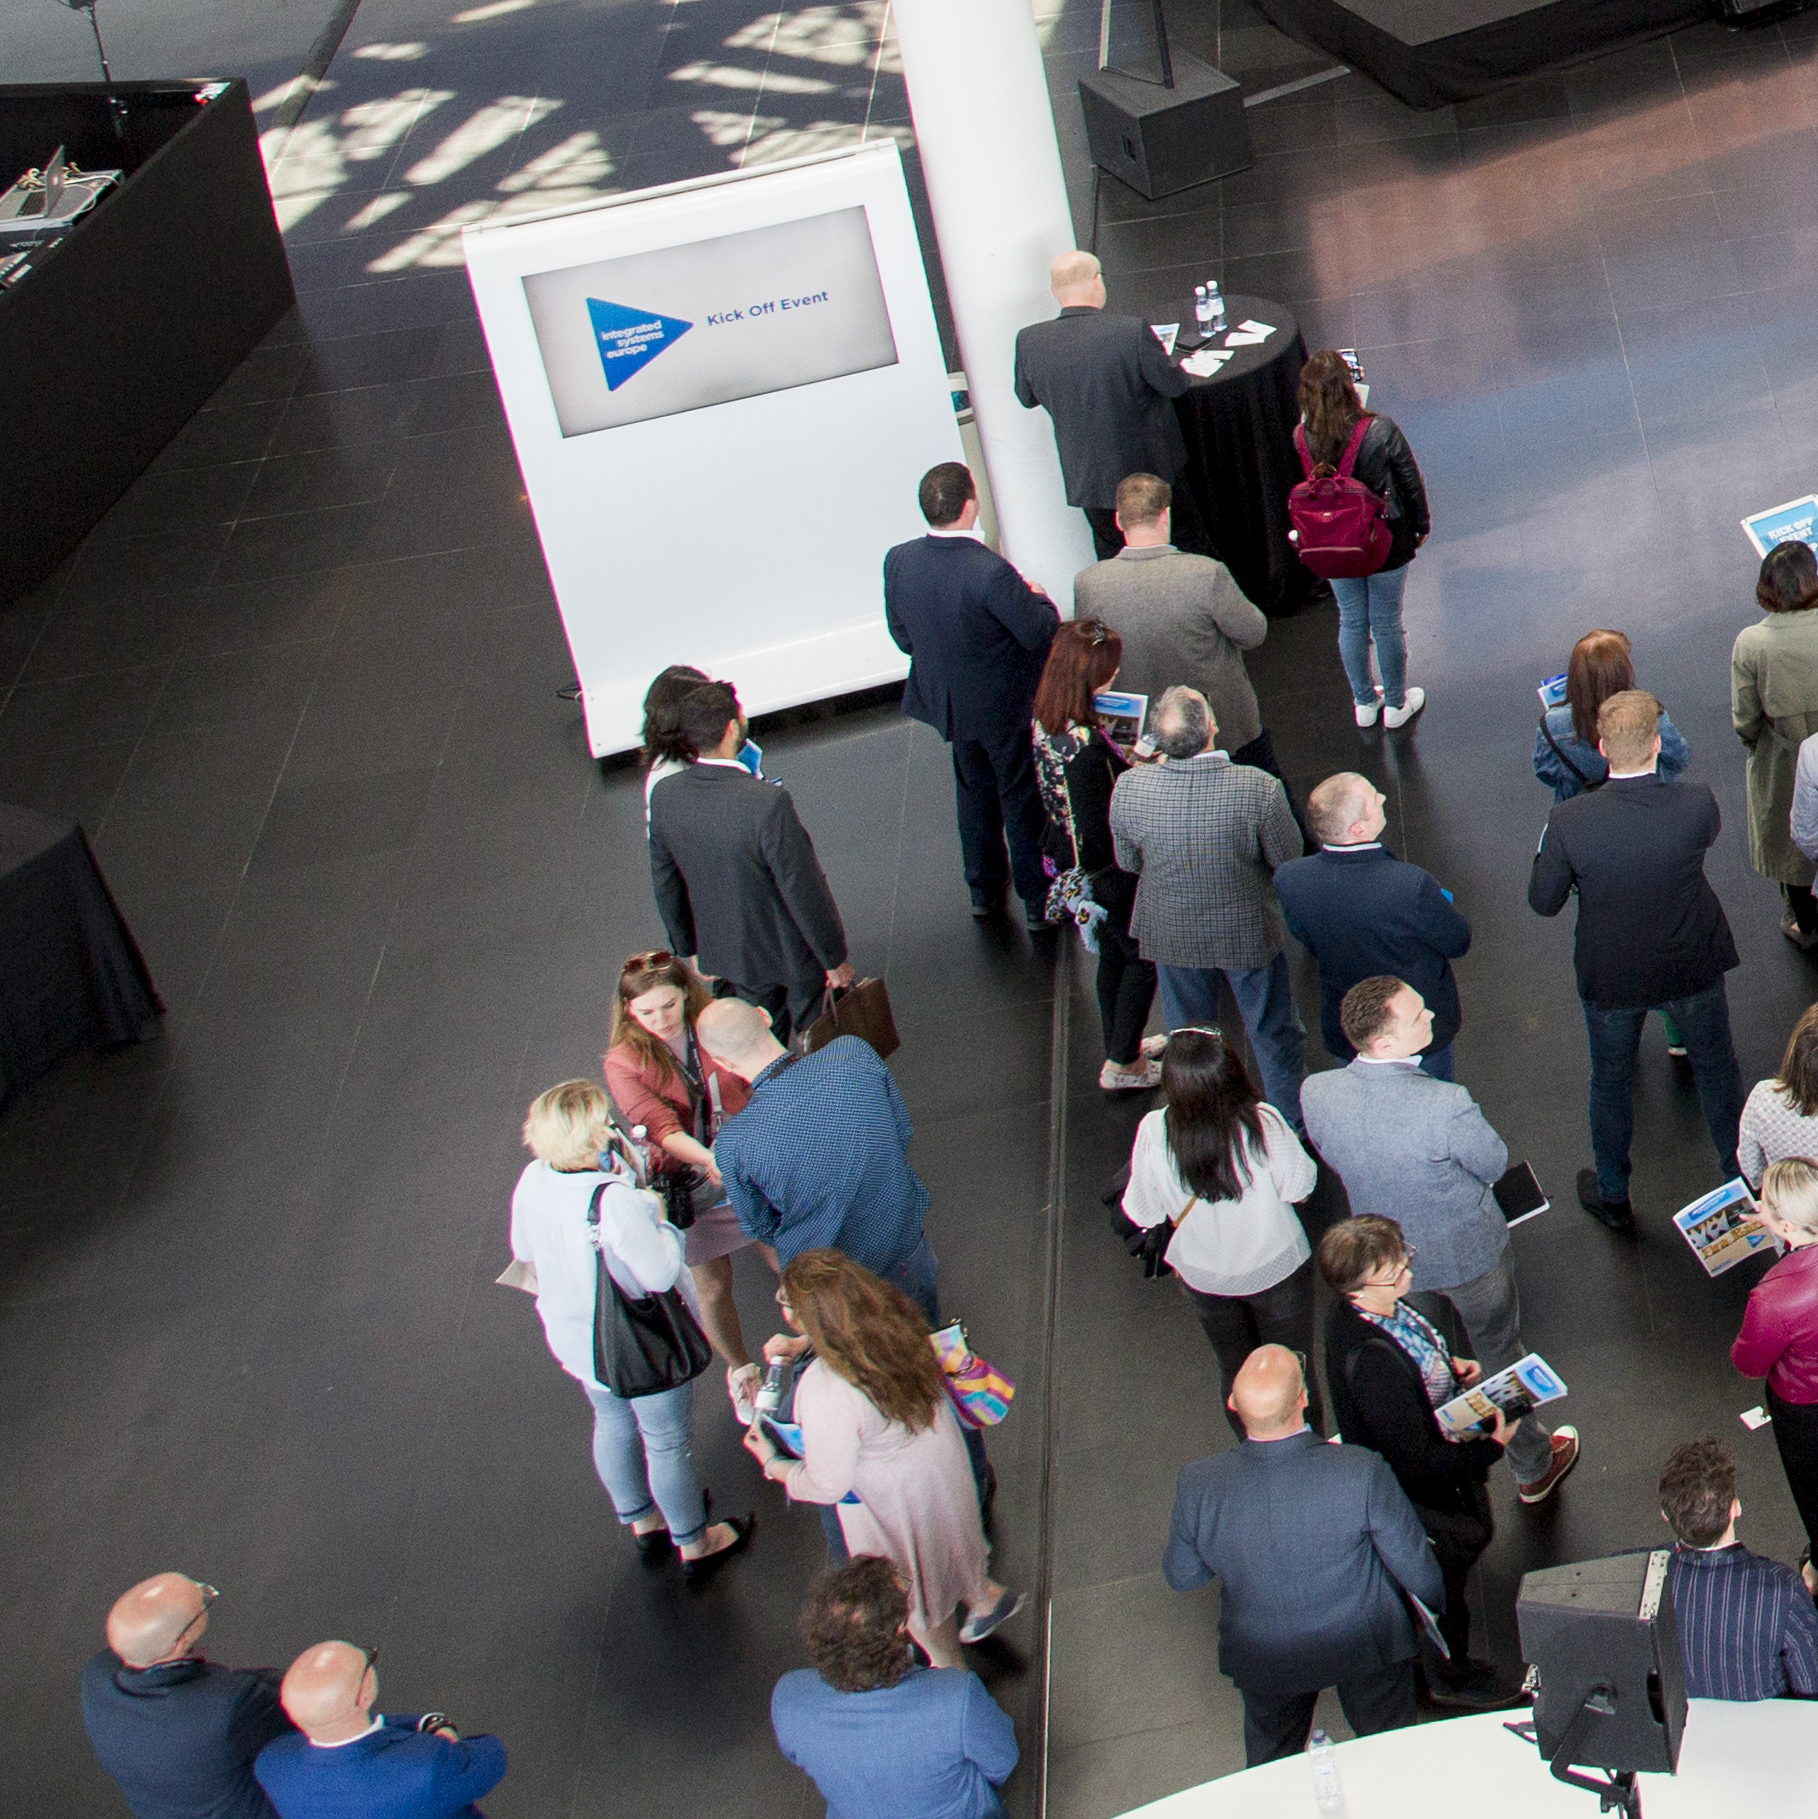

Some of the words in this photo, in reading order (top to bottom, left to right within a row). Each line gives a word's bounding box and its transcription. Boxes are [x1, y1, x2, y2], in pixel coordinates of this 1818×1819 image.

[707, 309, 744, 326] Kick
[749, 301, 775, 317] Off
[781, 291, 829, 310] Event
[602, 320, 662, 341] integrated
[617, 331, 664, 348] systems
[606, 344, 647, 359] europe
[1768, 524, 1794, 540] KICK
